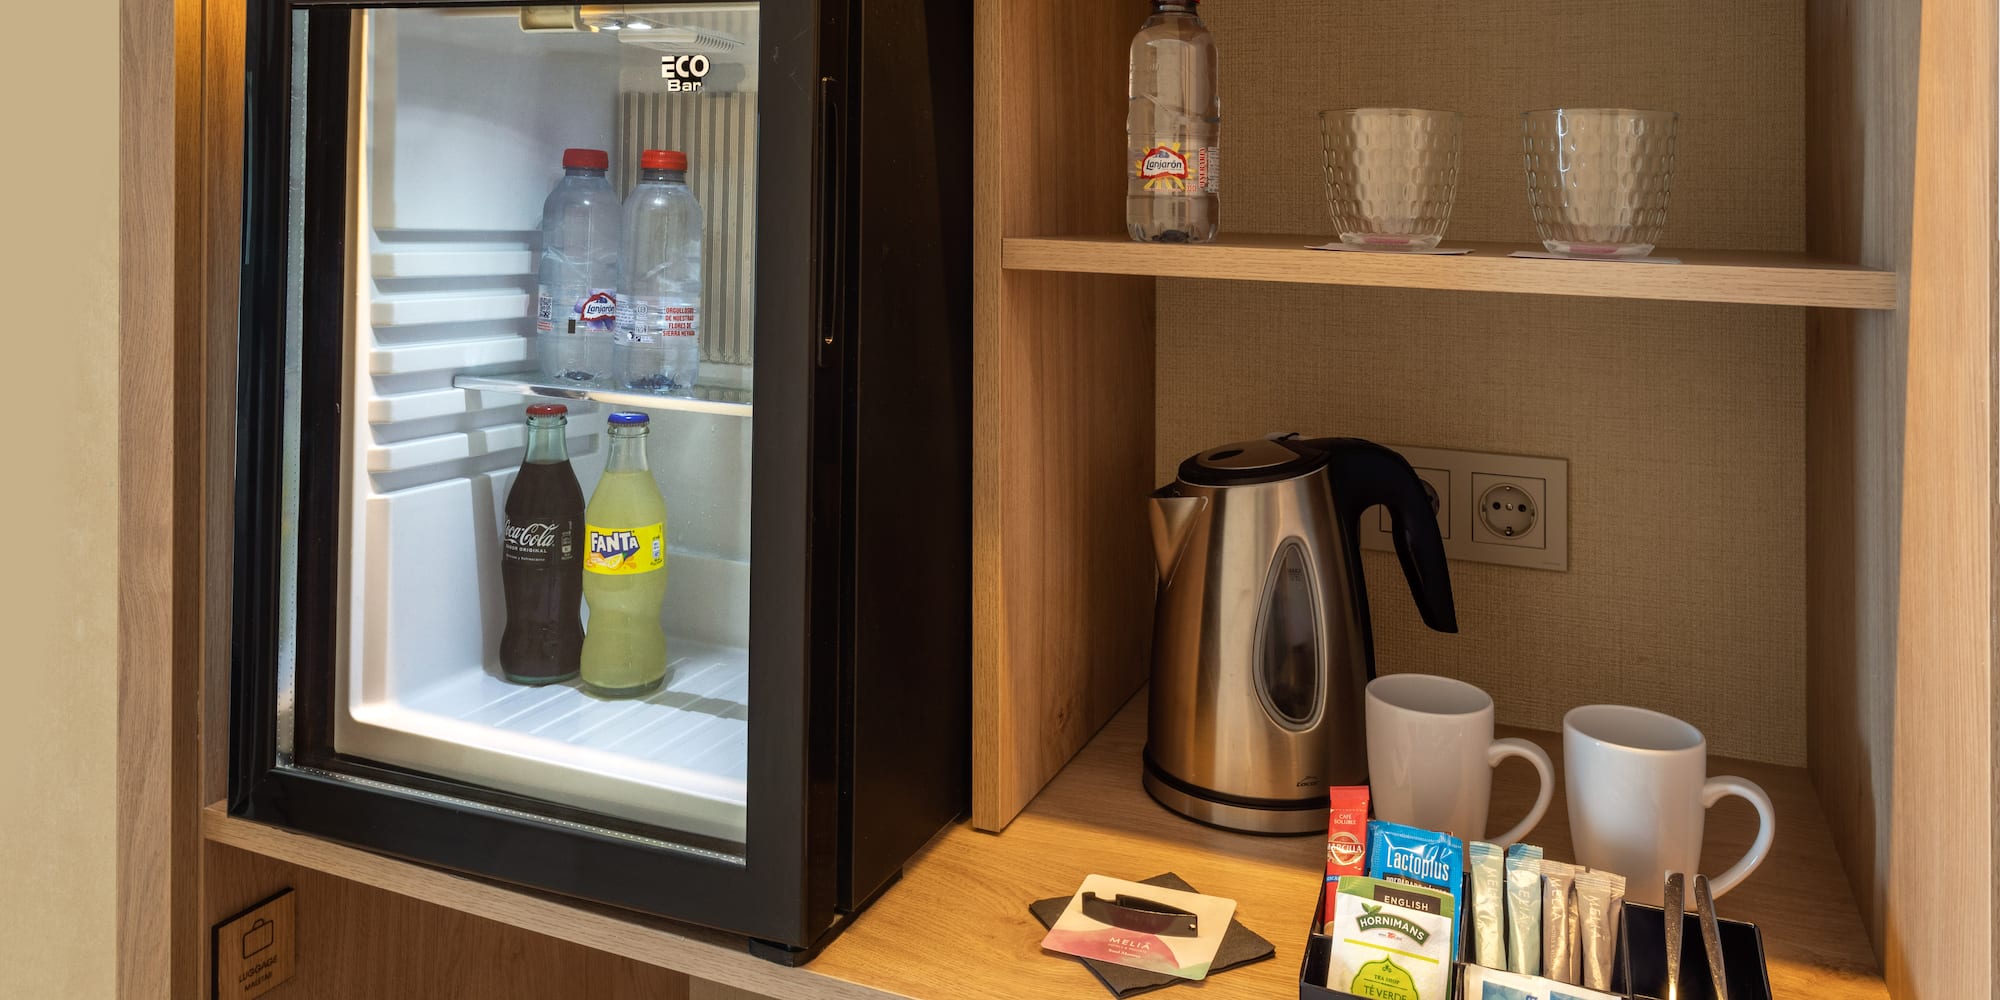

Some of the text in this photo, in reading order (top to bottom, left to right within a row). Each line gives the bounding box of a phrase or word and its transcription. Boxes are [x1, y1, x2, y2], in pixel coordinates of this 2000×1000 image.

[661, 54, 709, 78] ECO
[667, 79, 702, 92] Bar
[1146, 158, 1182, 170] Lanjarón
[519, 546, 547, 554] ORIGINAL
[591, 530, 639, 552] FANTA
[1387, 846, 1450, 882] Lactoplus
[1384, 895, 1429, 911] ENGLISH
[1360, 916, 1425, 941] HORNIMANS
[238, 954, 278, 984] LUGGAGE
[1364, 983, 1376, 995] TÉ
